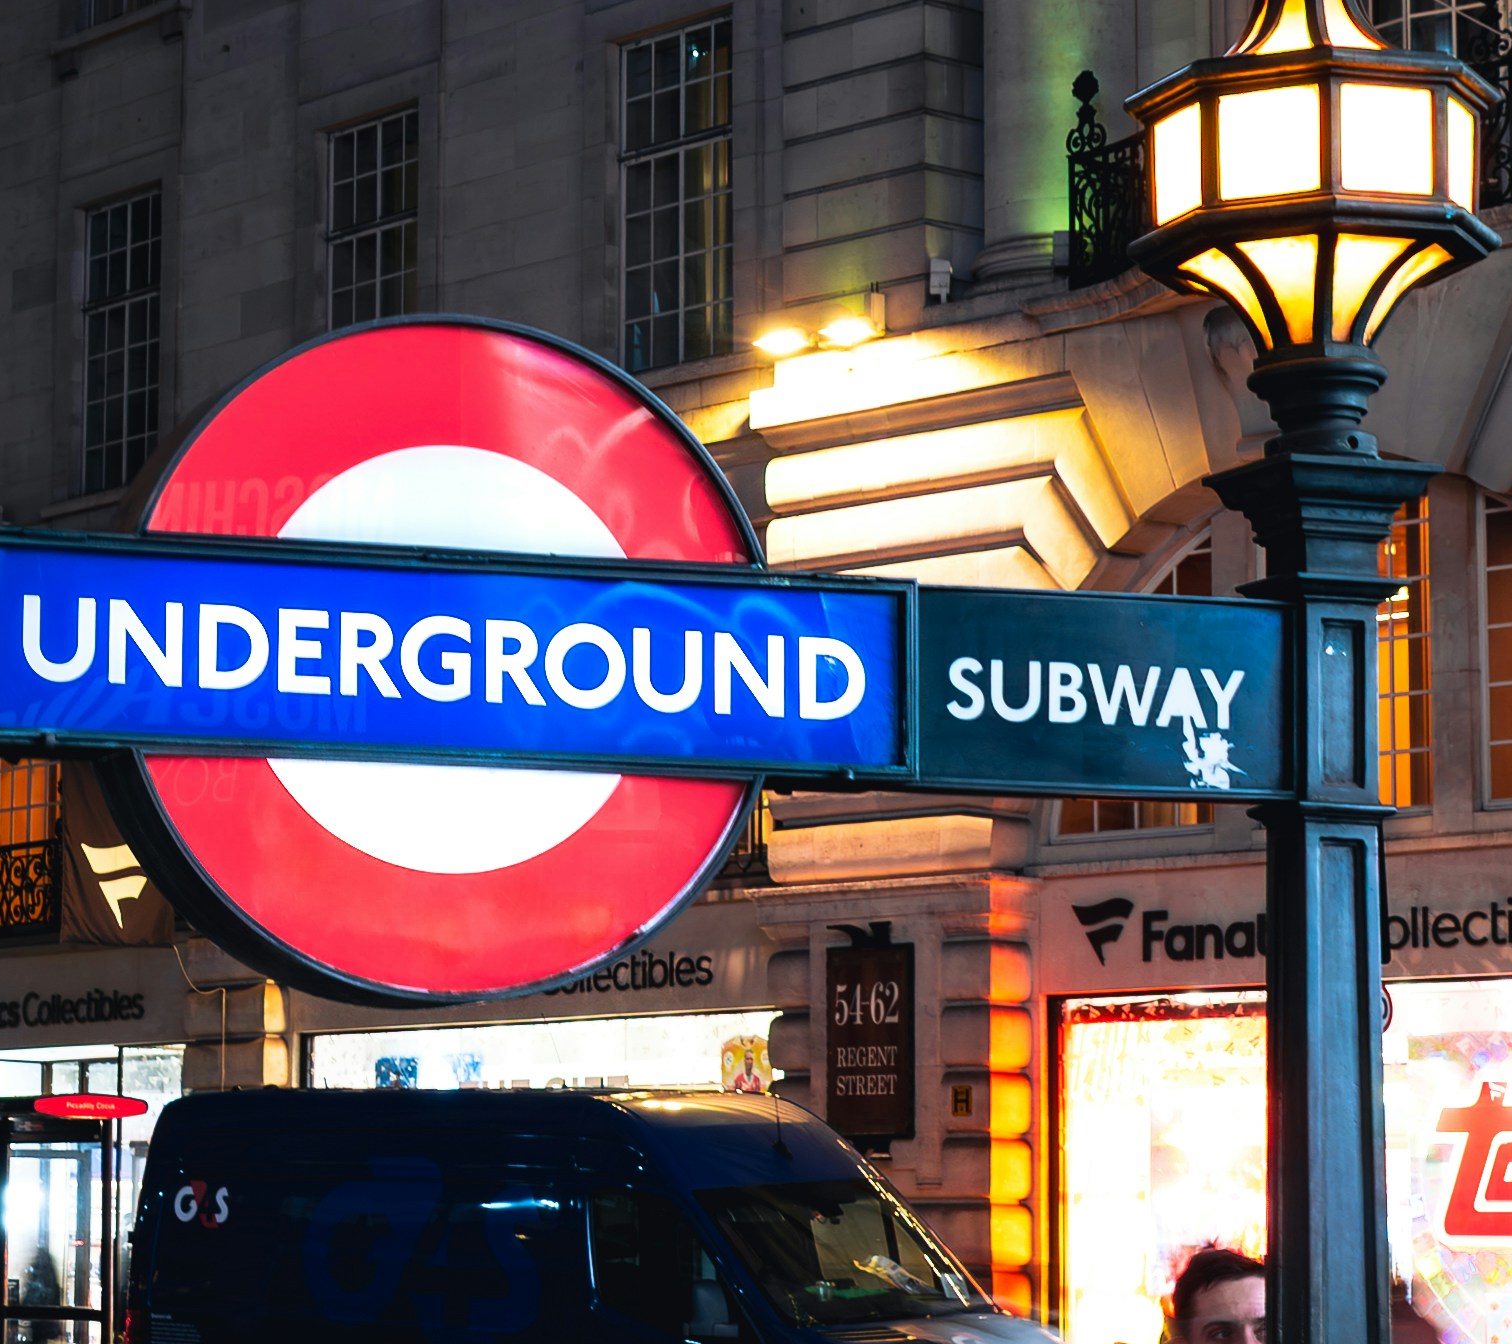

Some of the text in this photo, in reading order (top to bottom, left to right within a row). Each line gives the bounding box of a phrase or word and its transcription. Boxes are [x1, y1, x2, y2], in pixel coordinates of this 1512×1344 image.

[22, 594, 868, 724] UNDERGROUND
[947, 656, 1246, 732] SUBWAY
[1142, 910, 1267, 962] Fana
[22, 988, 144, 1027] Collectibles
[835, 981, 899, 1026] 54-62
[836, 1046, 898, 1067] REGENT
[66, 1101, 116, 1110] Piccadilly Circus
[836, 1074, 898, 1096] STREET
[174, 1180, 229, 1229] G4S
